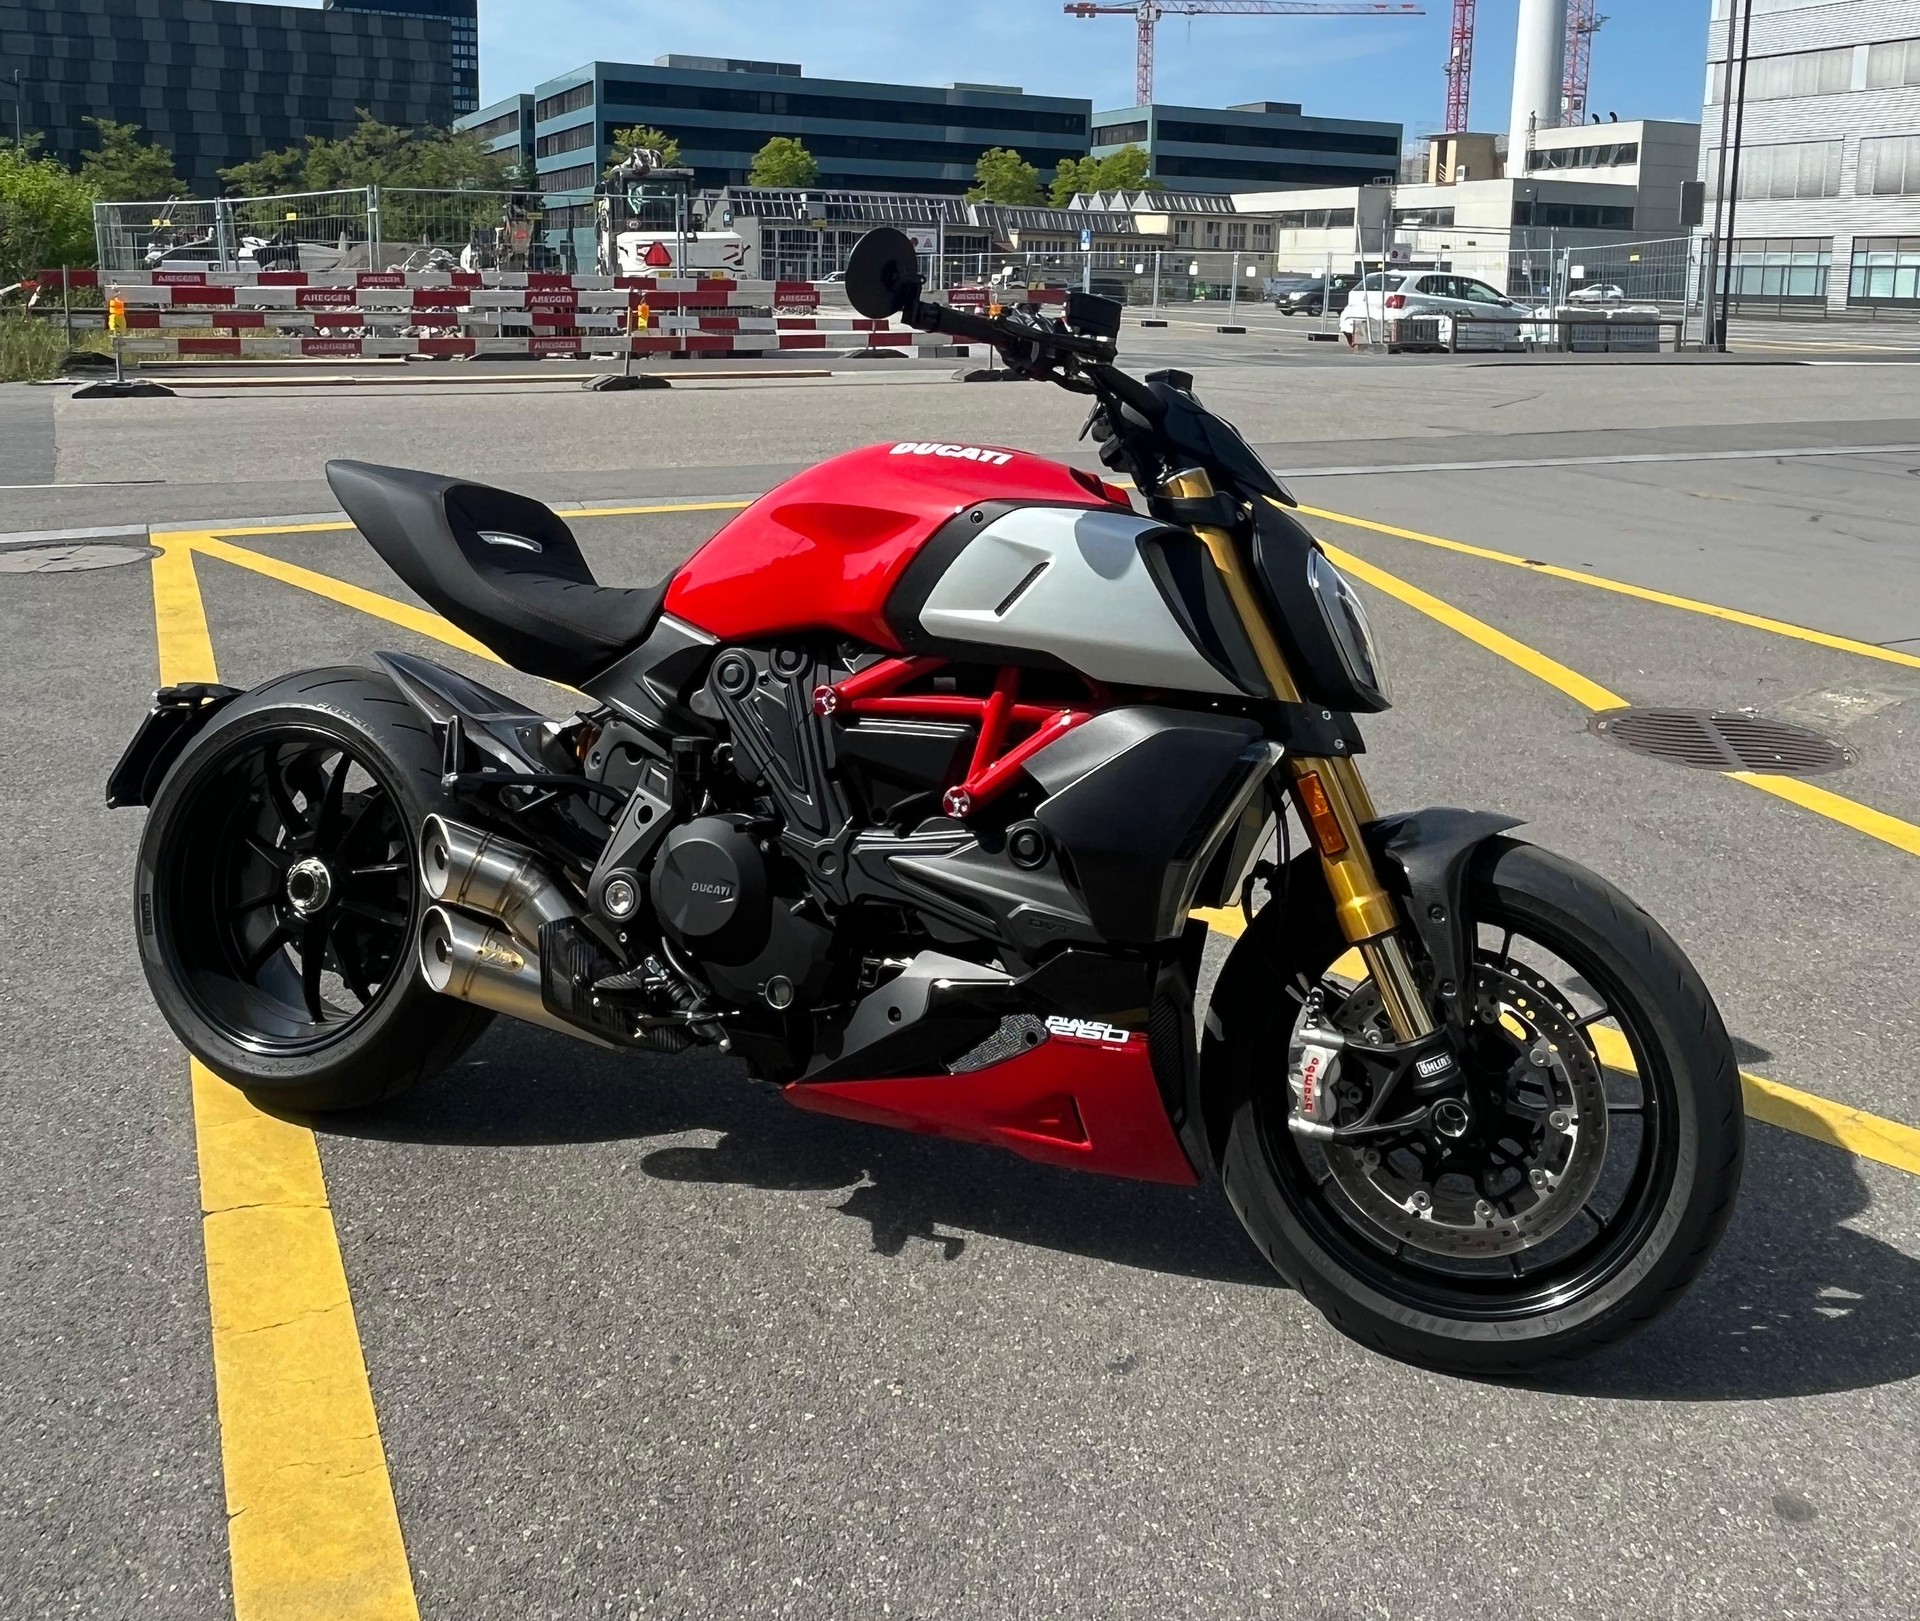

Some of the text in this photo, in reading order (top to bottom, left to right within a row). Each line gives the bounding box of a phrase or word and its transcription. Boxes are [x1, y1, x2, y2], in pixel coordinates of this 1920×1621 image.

[302, 294, 351, 302] AREGGER
[530, 295, 573, 303] AREGGER
[889, 442, 1013, 465] DUCATI
[691, 882, 730, 897] DUCATI
[1304, 1057, 1319, 1112] brembo
